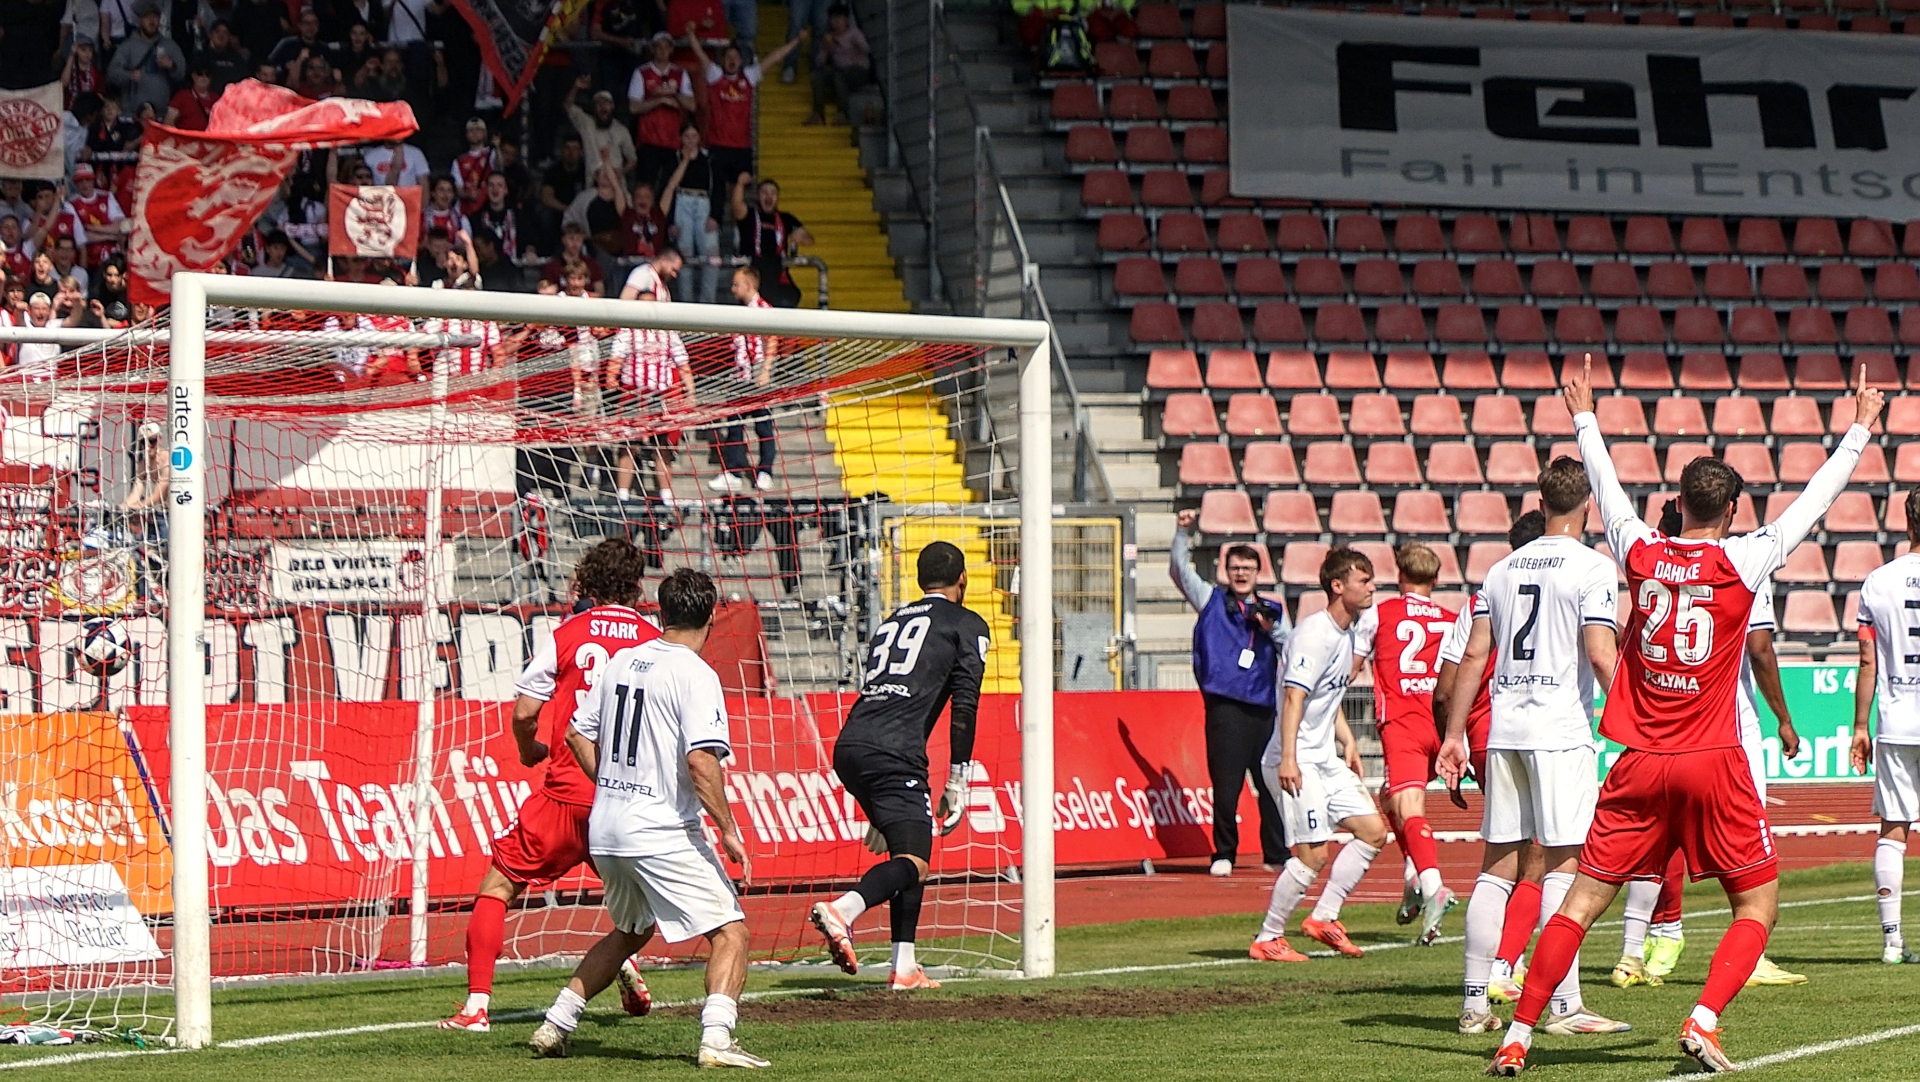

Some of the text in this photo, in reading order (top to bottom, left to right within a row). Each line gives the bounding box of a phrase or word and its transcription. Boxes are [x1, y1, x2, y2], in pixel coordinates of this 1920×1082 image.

[1336, 40, 1918, 151] Fehr
[1341, 147, 1523, 188] Fair
[1567, 158, 1644, 194] in
[174, 385, 192, 442] artec
[289, 559, 325, 571] RED
[1507, 556, 1565, 571] HILDEBRANDT
[1654, 560, 1701, 583] DAHLKE
[590, 619, 639, 641] STARK
[1396, 619, 1455, 674] 27
[1513, 584, 1541, 660] 2
[1638, 579, 1714, 666] 25
[866, 615, 932, 682] 39
[1813, 669, 1838, 694] KS
[612, 683, 644, 767] 11
[289, 760, 464, 863] Team
[1307, 808, 1318, 830] 6
[44, 885, 114, 914] Service
